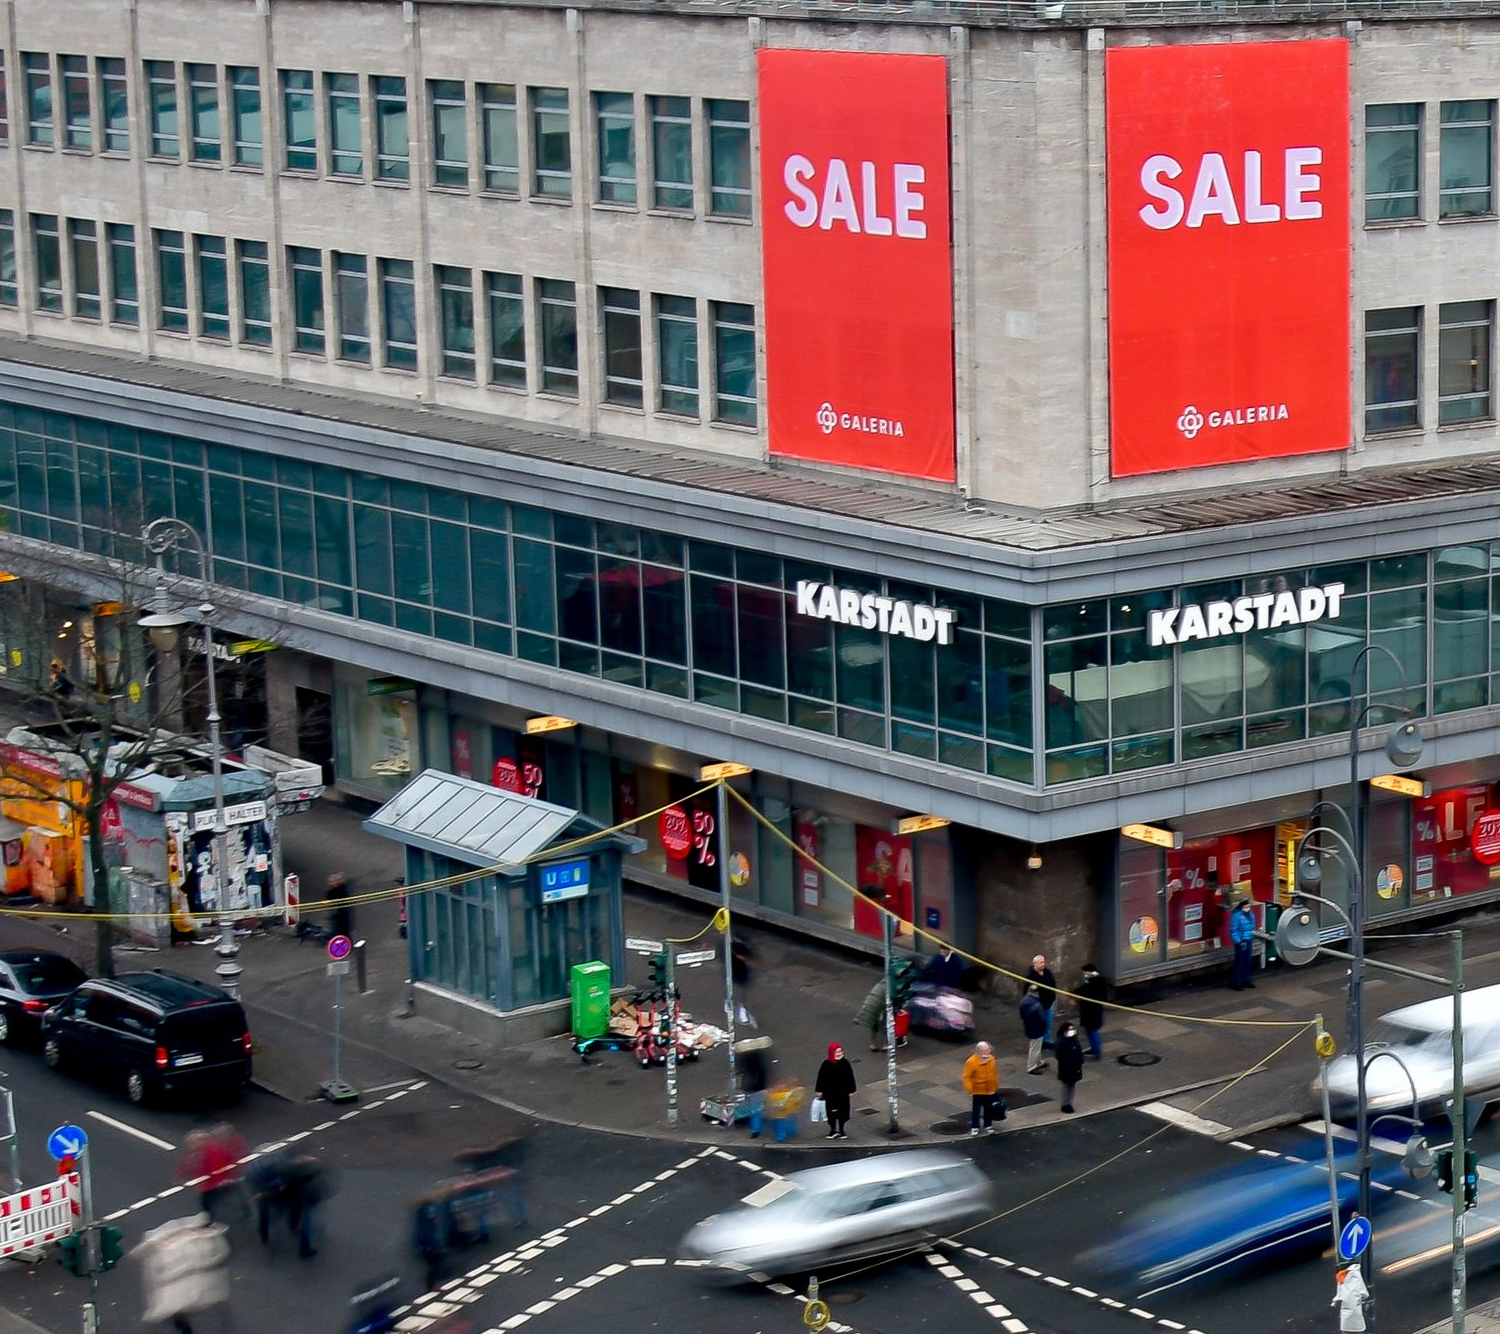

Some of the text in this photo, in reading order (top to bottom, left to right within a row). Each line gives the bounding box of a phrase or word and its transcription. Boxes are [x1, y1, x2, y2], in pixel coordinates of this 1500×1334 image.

[783, 153, 927, 240] SALE
[1139, 146, 1325, 230] SALE
[840, 412, 905, 438] GALERIA
[1208, 403, 1290, 429] GALERIA
[796, 579, 958, 646] KARSTADT
[1148, 581, 1346, 647] KARSTADT
[524, 763, 543, 786] 50
[229, 806, 264, 822] HALTER
[692, 810, 714, 835] 50
[695, 835, 715, 866] %
[547, 871, 557, 885] U
